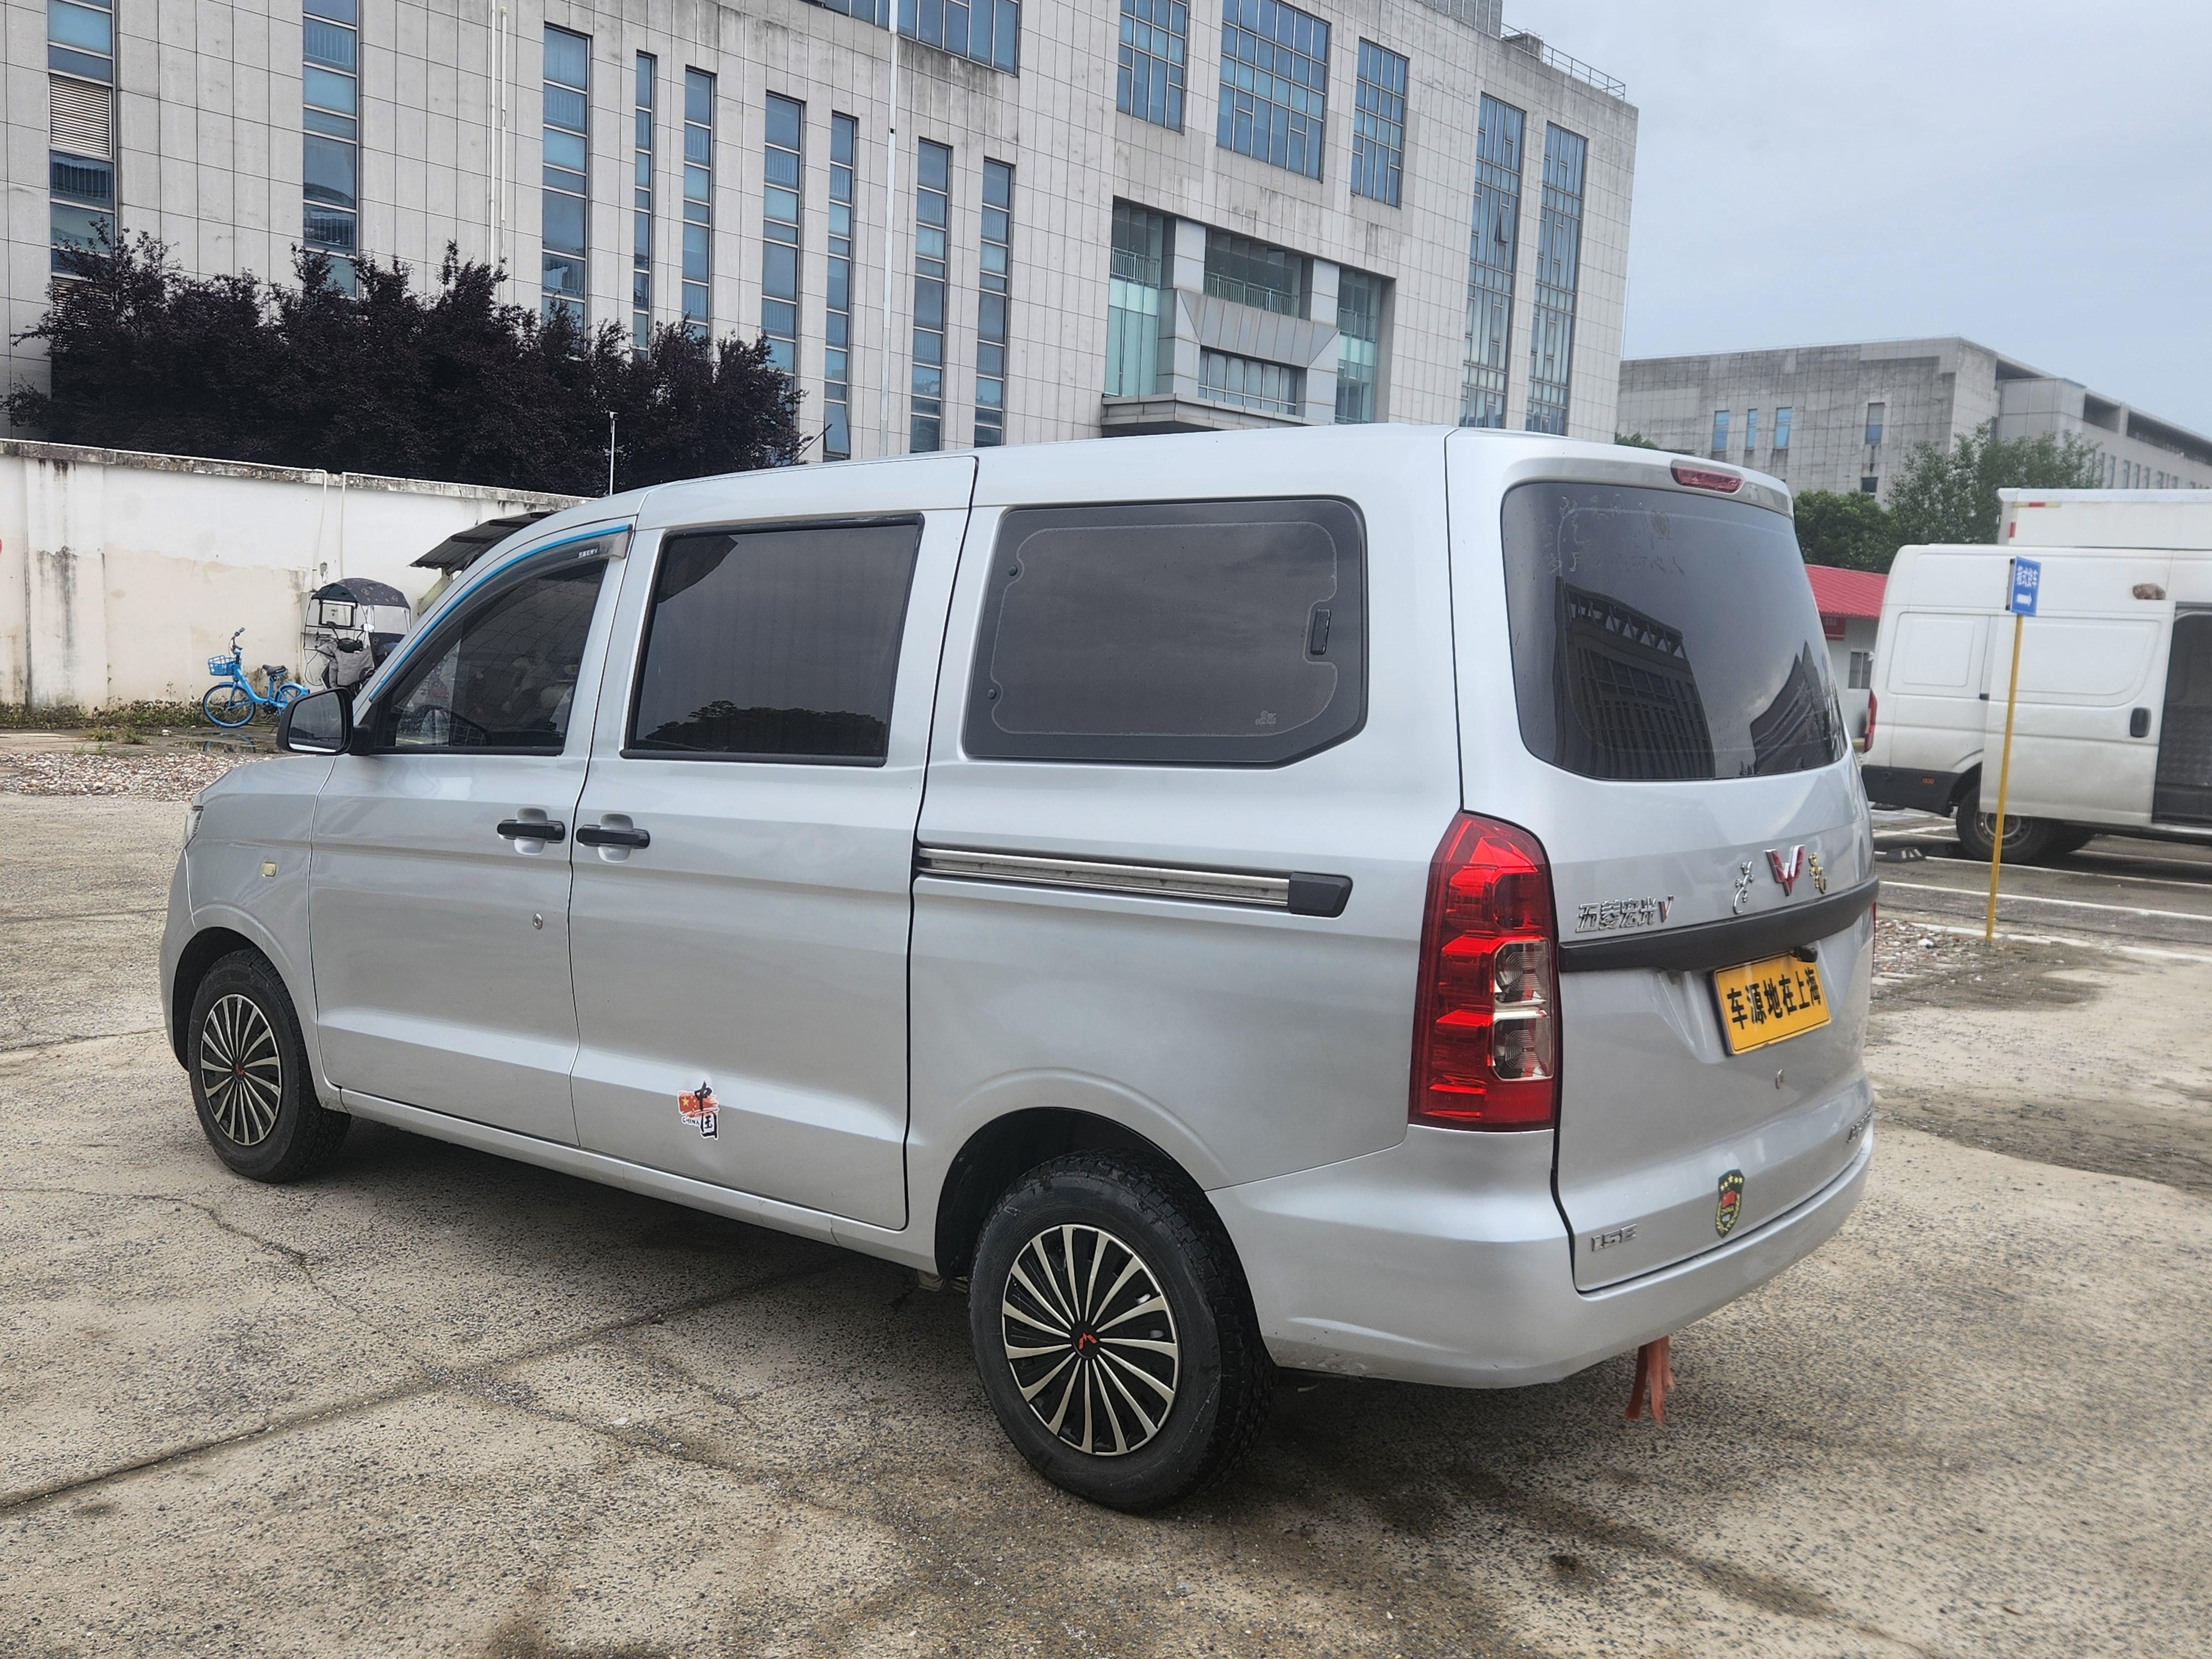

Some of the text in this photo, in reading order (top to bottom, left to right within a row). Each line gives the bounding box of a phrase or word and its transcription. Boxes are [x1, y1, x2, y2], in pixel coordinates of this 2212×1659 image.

[1726, 967, 1821, 1030] 车源地在上海
[682, 1117, 700, 1126] CHINA
[695, 1080, 718, 1138] 中国
